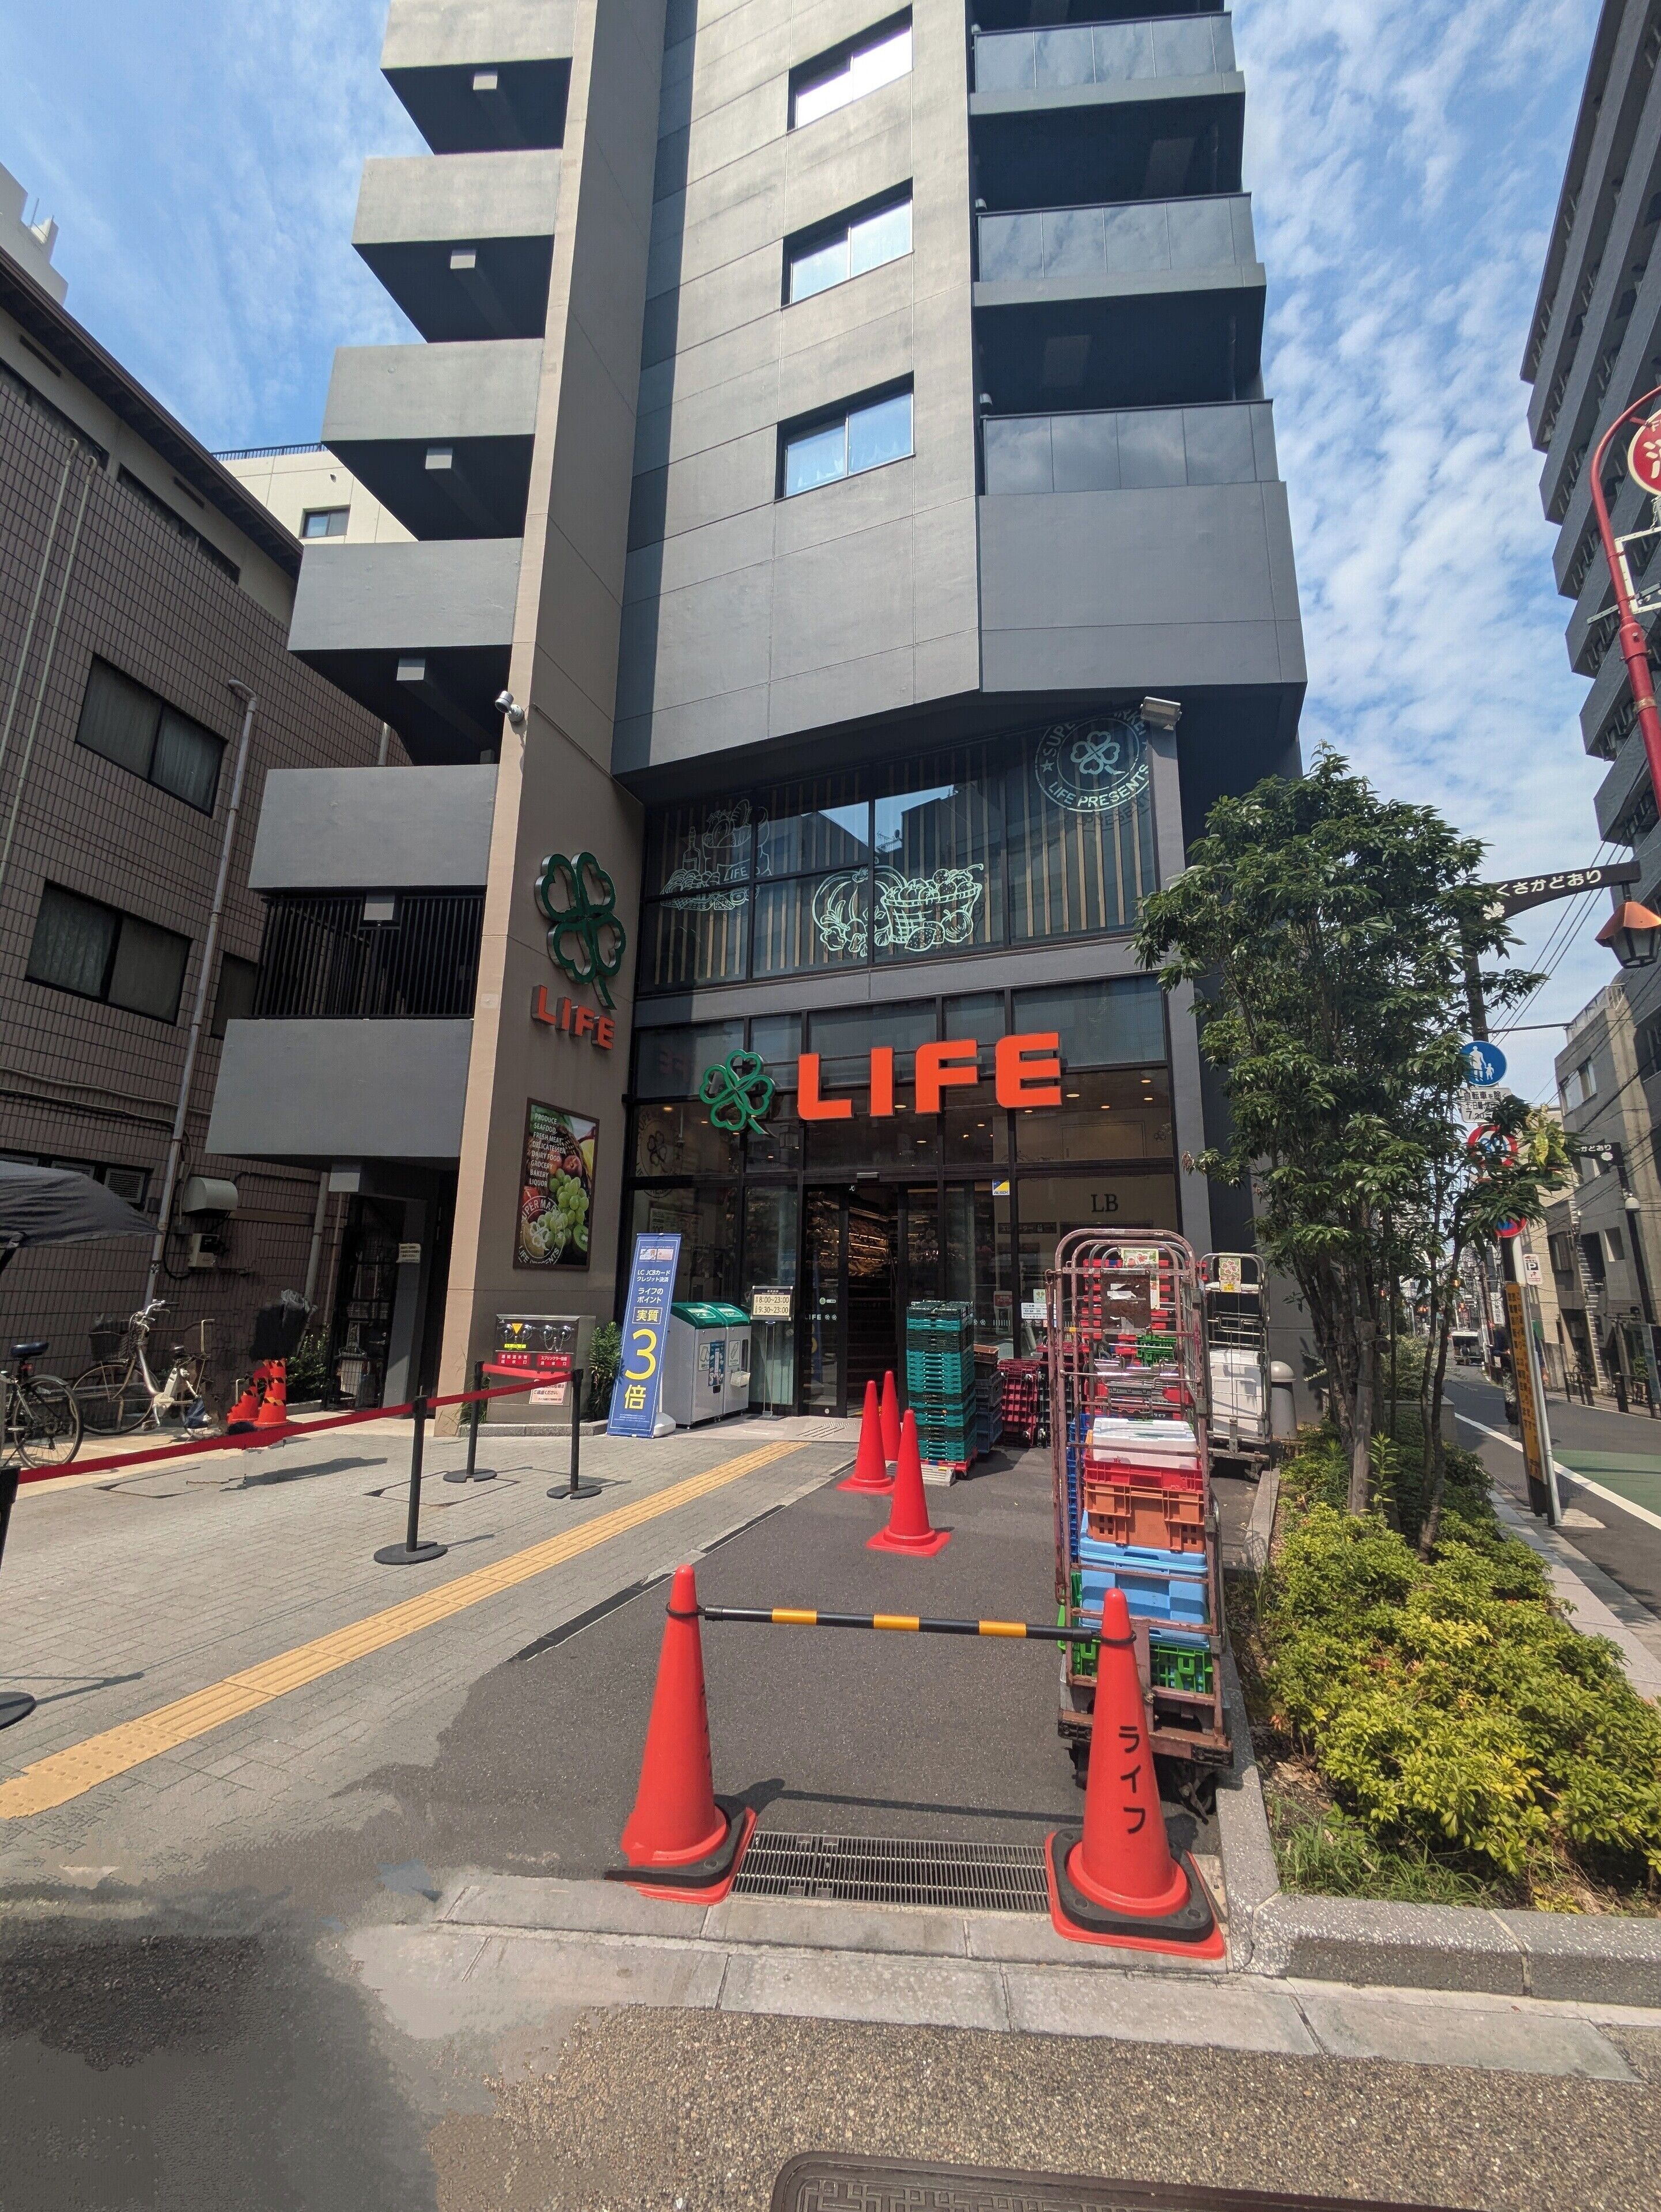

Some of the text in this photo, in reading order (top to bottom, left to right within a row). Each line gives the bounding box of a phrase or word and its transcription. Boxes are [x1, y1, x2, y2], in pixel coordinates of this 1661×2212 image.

[1048, 764, 1149, 808] LIFE PRESENTS
[724, 866, 748, 881] LIFE
[1493, 869, 1602, 897] くさかどおり
[531, 984, 615, 1050] LIFE
[798, 1031, 1062, 1120] LIFE
[535, 1113, 558, 1125] PRODUCE
[534, 1123, 557, 1134] SEAFOOD
[533, 1132, 564, 1144] FRESH MEAT
[532, 1141, 566, 1154] DELICATESSEN
[1576, 1144, 1612, 1152] かどおり
[531, 1150, 561, 1162] DAIRY FOOD
[531, 1160, 553, 1170] GROCERY
[529, 1169, 549, 1178] BAKERY
[529, 1178, 548, 1187] LIQUOR
[1091, 1193, 1119, 1213] LB
[636, 1309, 659, 1322] 実質
[625, 1328, 657, 1380] 3
[625, 1384, 646, 1410] 倍
[1118, 1725, 1146, 1835] ライフ
